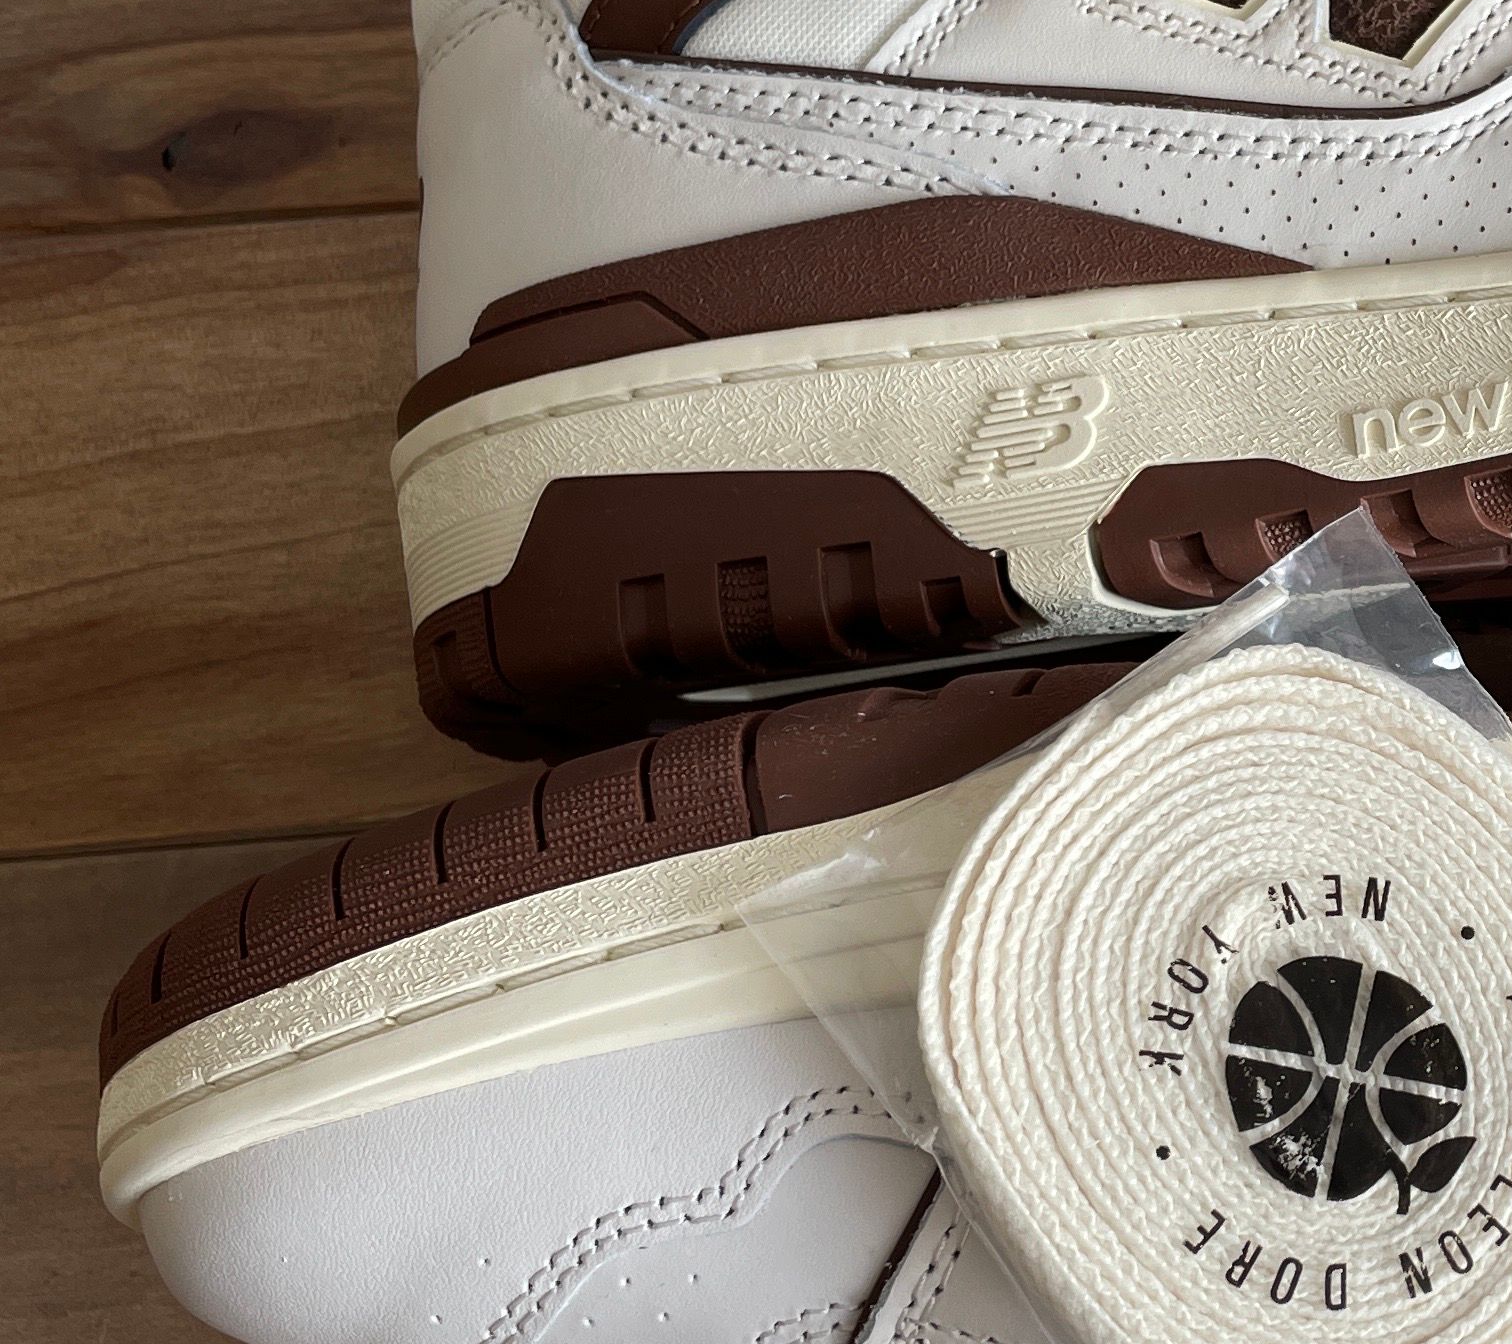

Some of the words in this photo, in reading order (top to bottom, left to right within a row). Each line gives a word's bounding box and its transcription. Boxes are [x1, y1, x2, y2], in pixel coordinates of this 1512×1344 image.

[1352, 378, 1512, 458] new
[1267, 873, 1392, 930] NEW
[1138, 923, 1239, 1076] YORK
[1181, 1208, 1348, 1311] DORE
